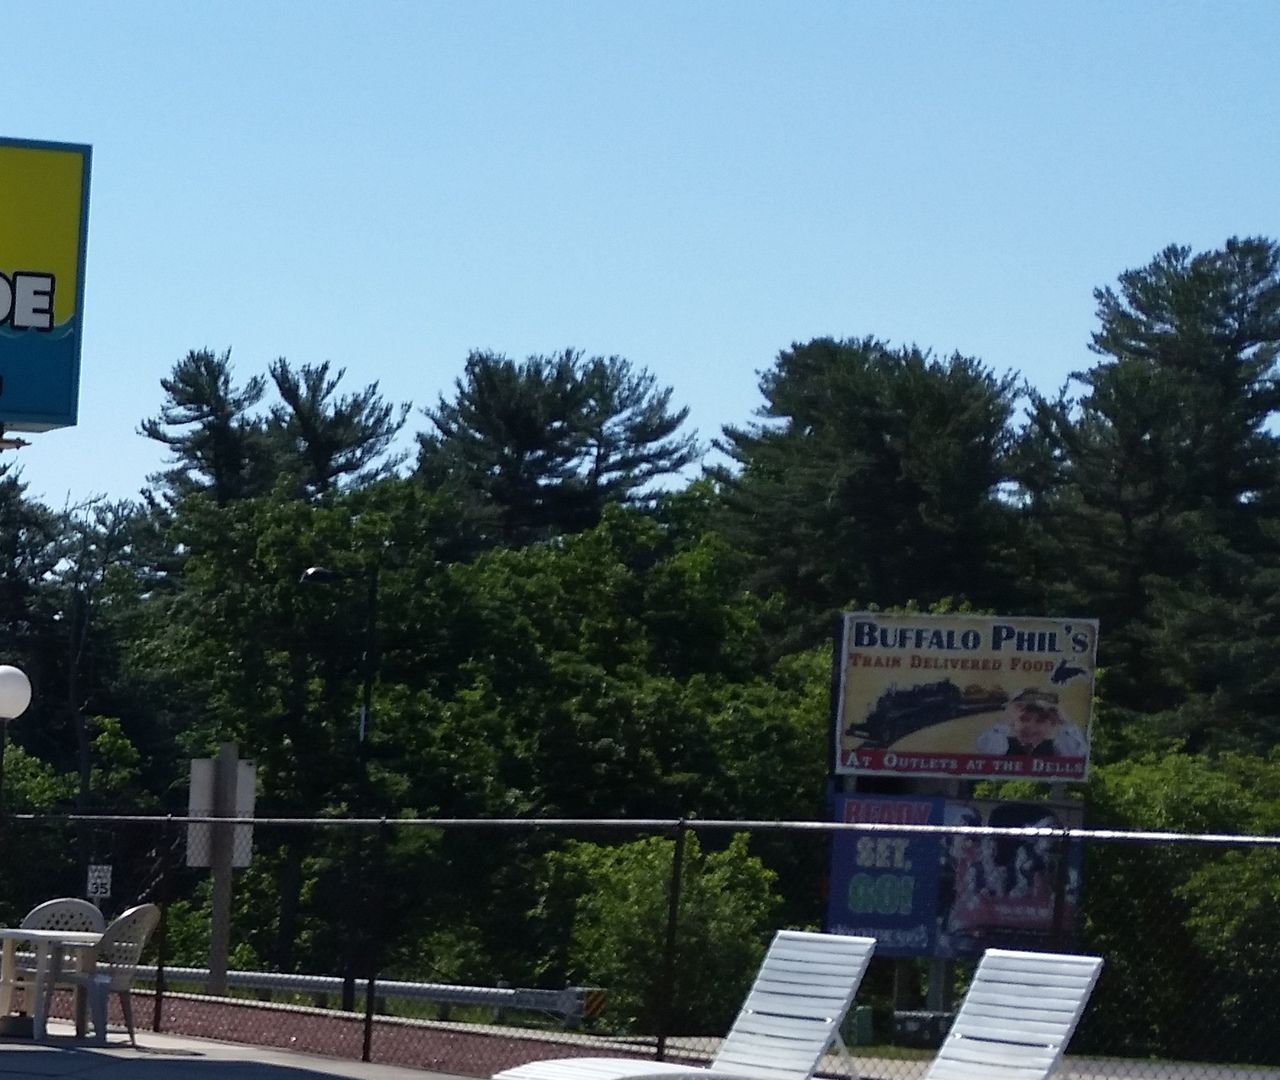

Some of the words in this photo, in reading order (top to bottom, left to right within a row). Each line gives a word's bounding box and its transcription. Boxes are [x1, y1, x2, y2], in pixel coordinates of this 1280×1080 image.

[854, 622, 981, 650] BUFFALO
[991, 624, 1089, 653] PHIL'S
[848, 653, 902, 668] TRAIN
[910, 655, 1002, 671] DELIVERED
[1010, 658, 1055, 672] FOOD
[883, 753, 958, 769] OUTLETS
[992, 760, 1024, 772] THE
[1031, 758, 1085, 774] DELLS
[91, 882, 108, 895] 35
